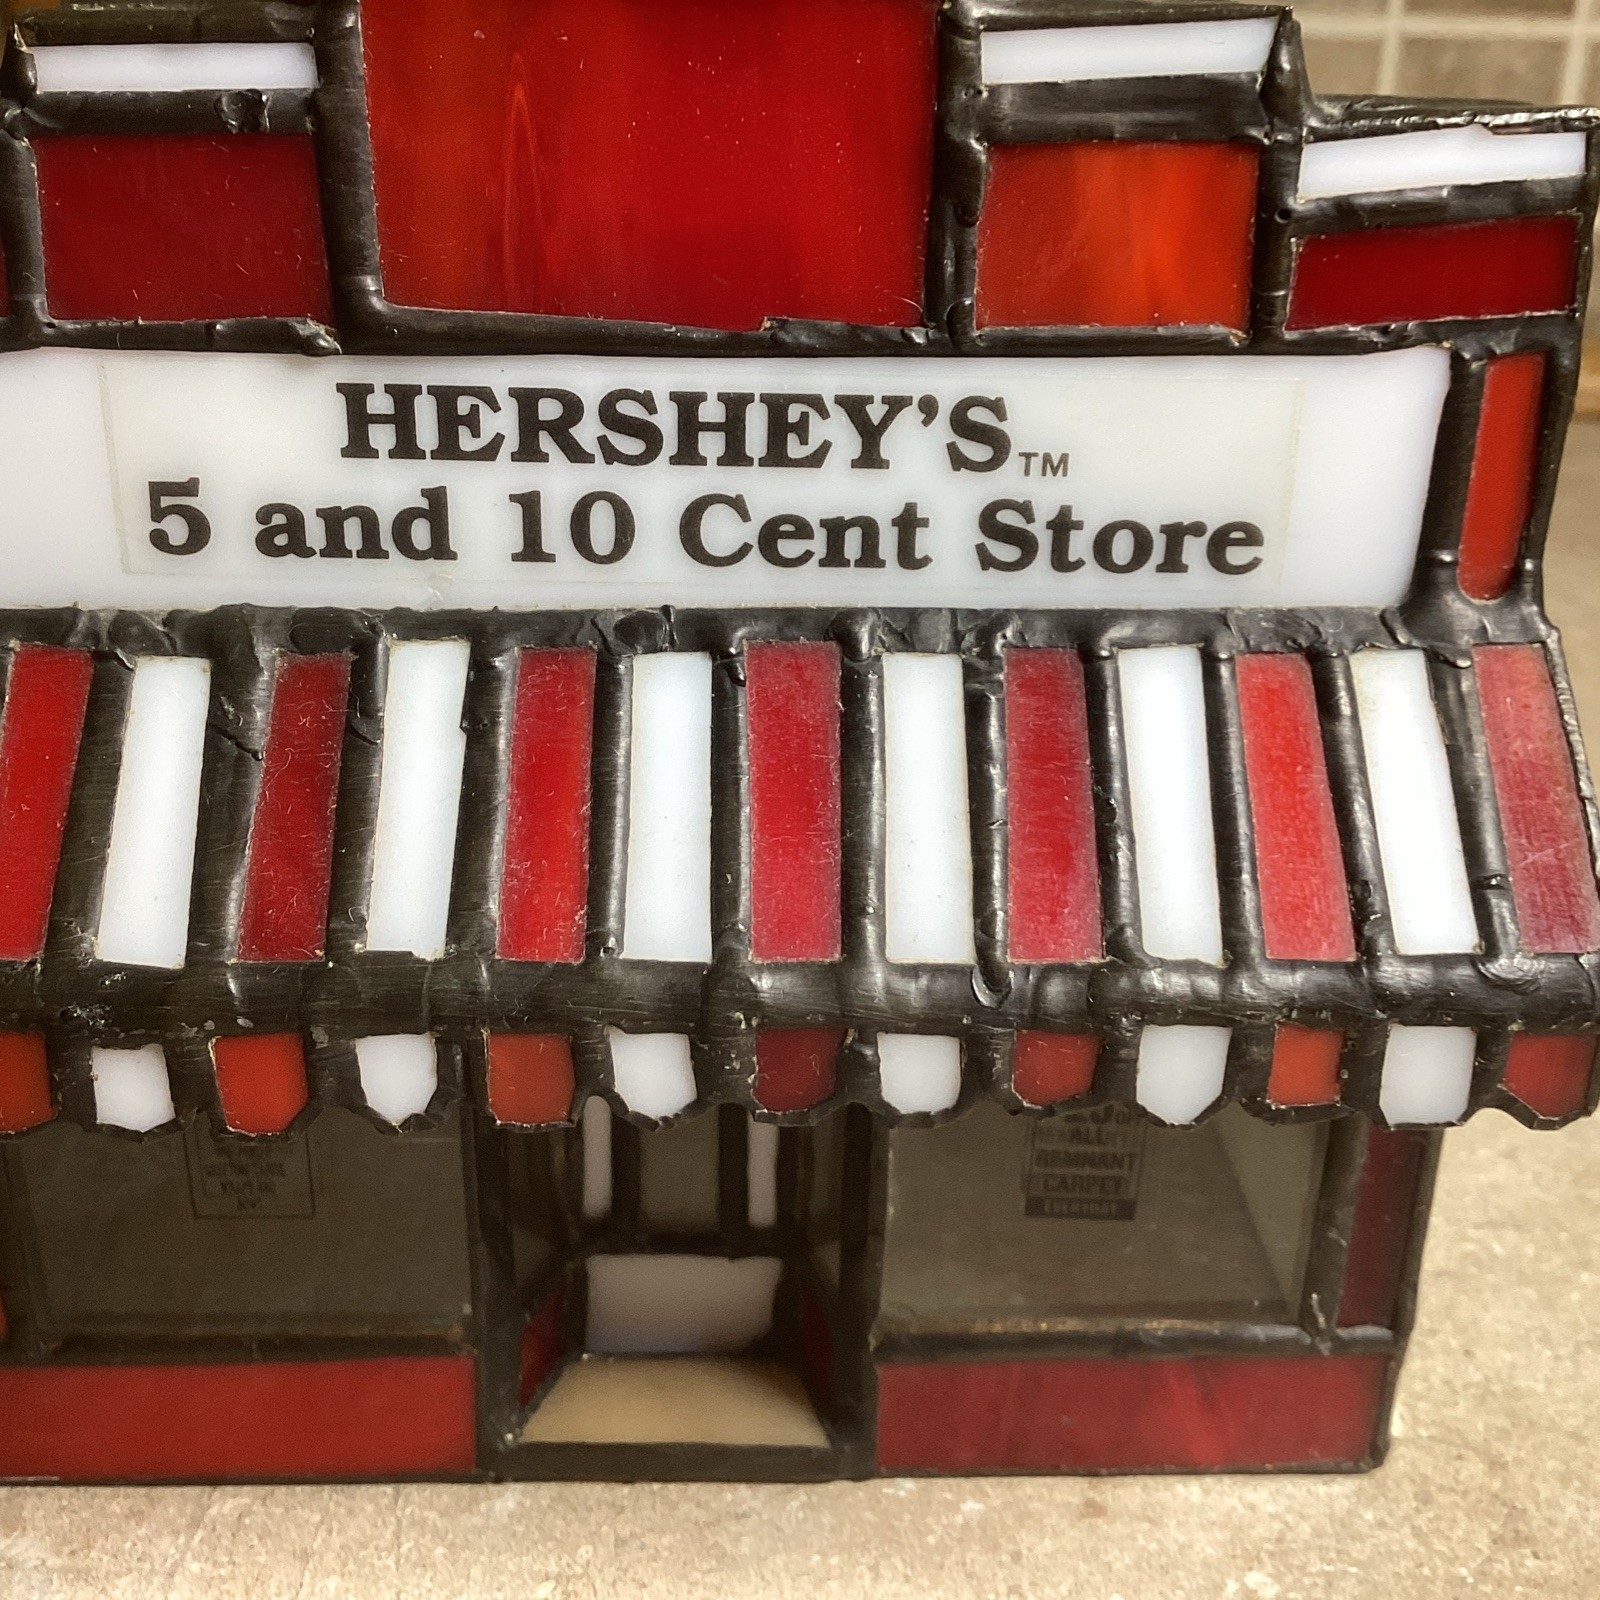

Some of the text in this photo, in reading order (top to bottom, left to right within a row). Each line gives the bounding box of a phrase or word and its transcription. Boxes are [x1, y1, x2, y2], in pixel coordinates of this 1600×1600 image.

[335, 382, 1012, 473] HERSHEY'S
[148, 477, 1264, 576] 5 and 10 Cent Store
[1042, 1173, 1126, 1194] CARPET
